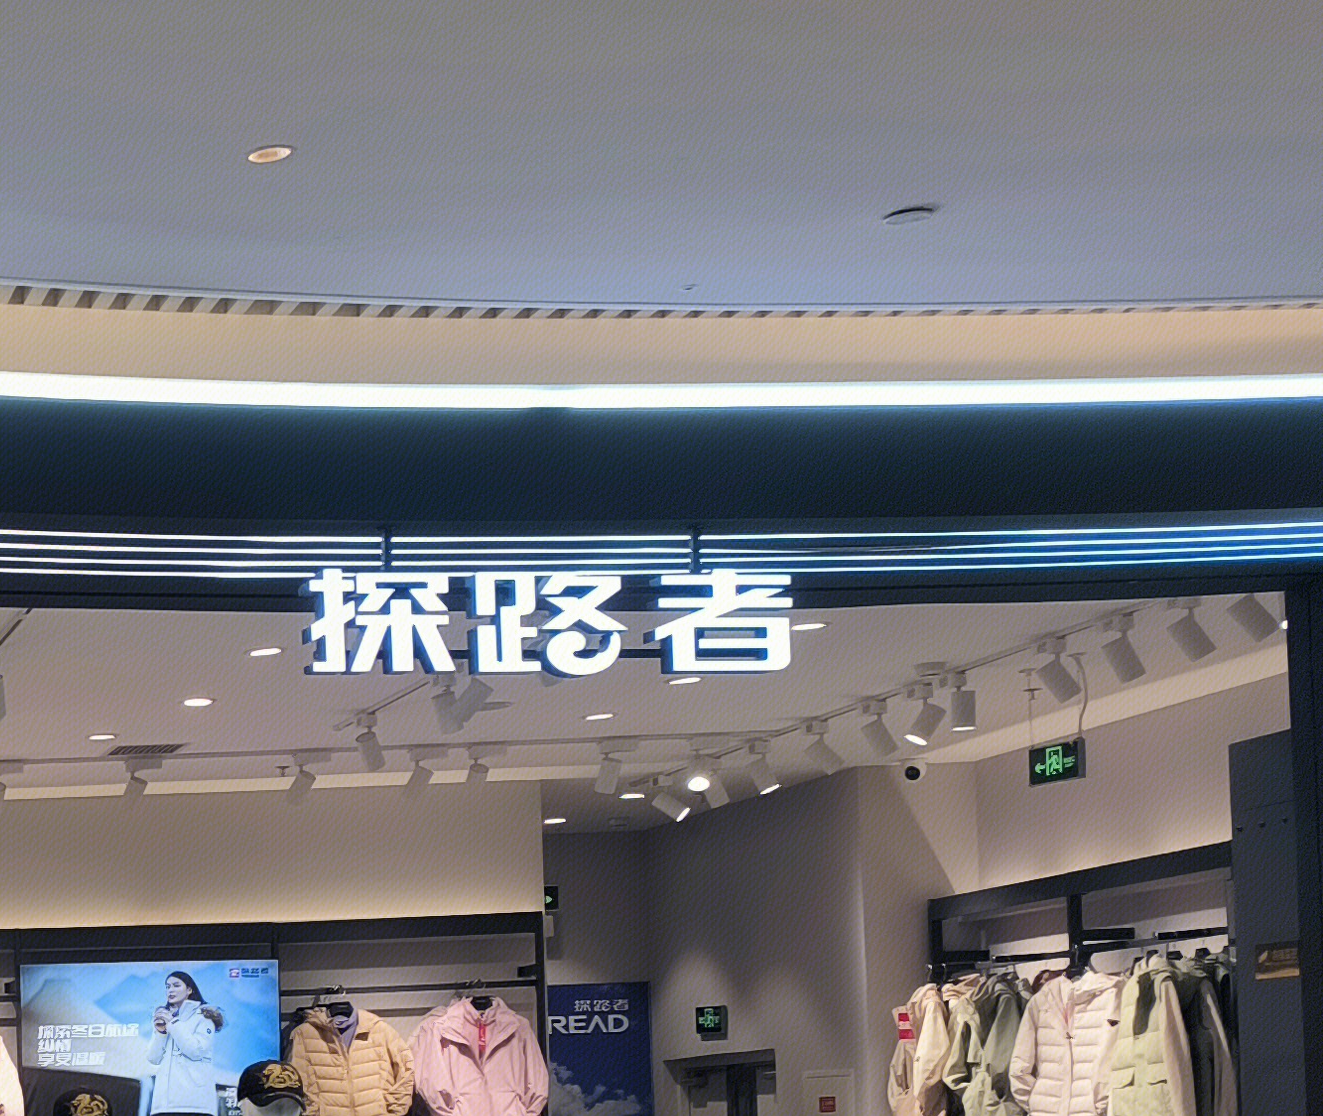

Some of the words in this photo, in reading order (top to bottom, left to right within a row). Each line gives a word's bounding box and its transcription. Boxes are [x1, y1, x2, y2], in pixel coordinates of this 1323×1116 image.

[307, 568, 793, 676] 探路者
[574, 999, 629, 1011] 探路者
[38, 1052, 106, 1067] 享受温暖
